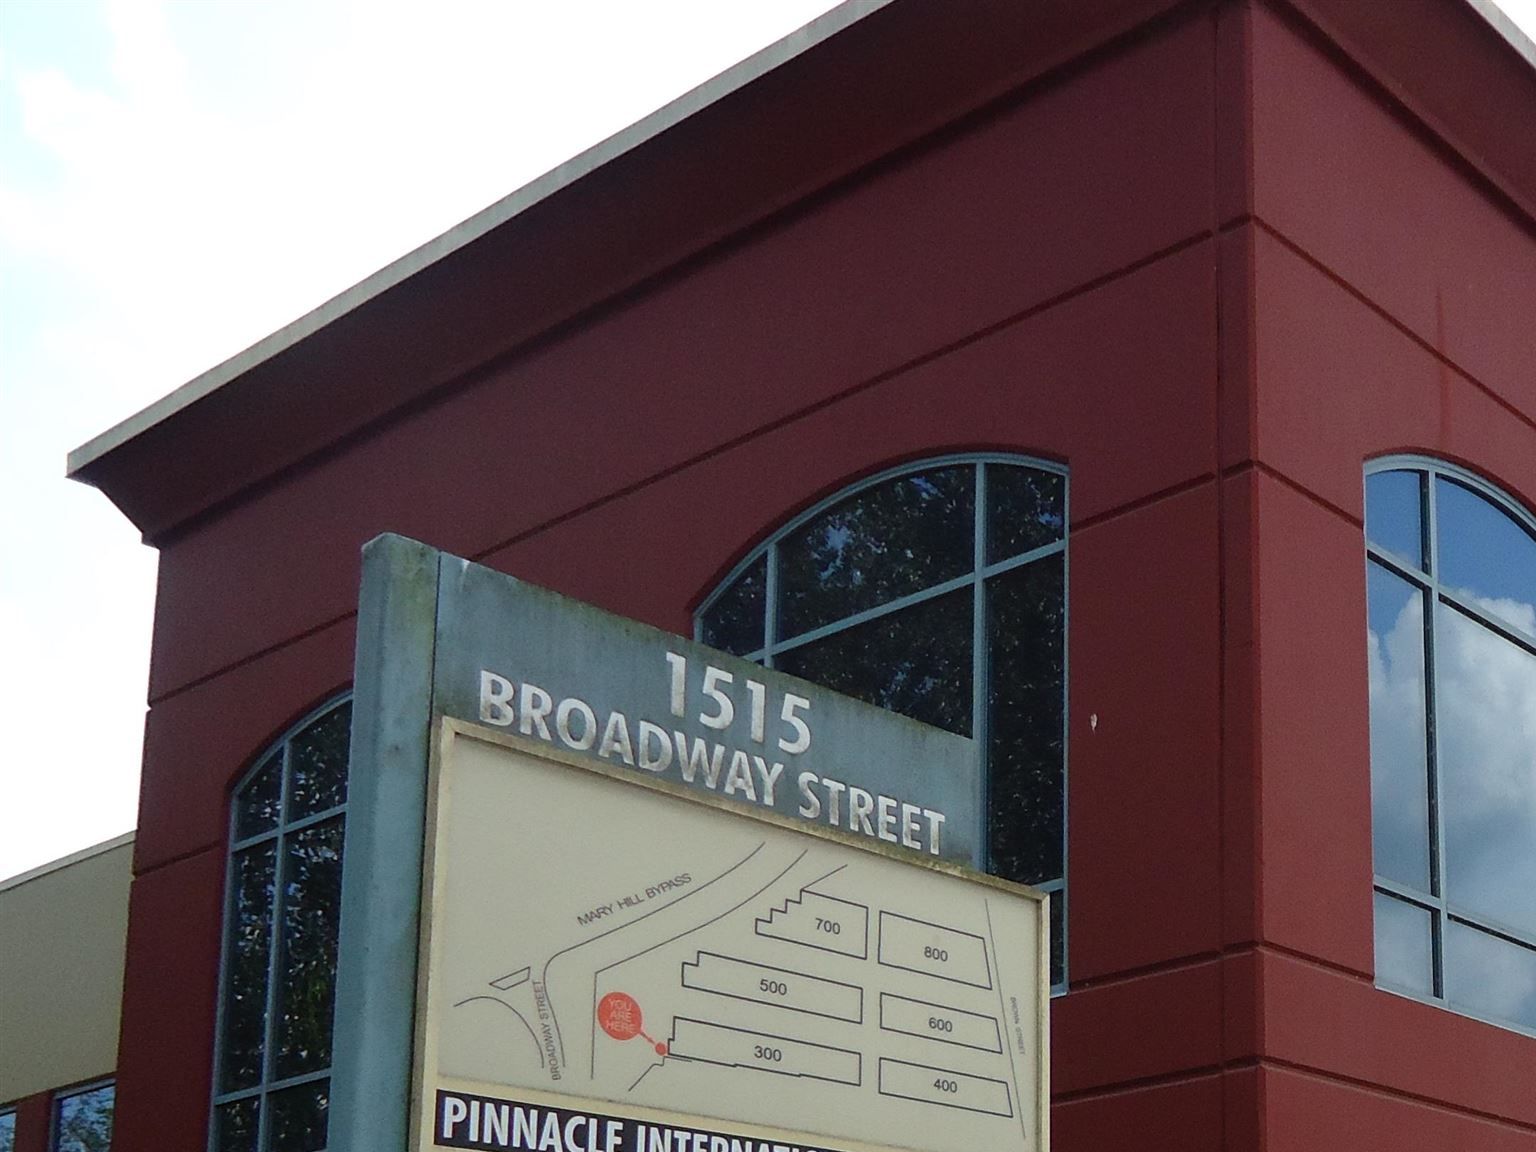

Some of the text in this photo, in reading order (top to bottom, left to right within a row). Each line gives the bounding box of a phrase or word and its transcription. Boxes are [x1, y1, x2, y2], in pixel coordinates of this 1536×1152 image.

[666, 651, 811, 755] 1515
[479, 669, 945, 855] BROADWAY STREET
[577, 873, 692, 926] MARY HILL BYPASS
[815, 917, 841, 935] 700
[924, 946, 948, 962] 800
[759, 978, 787, 996] 500
[608, 998, 632, 1011] YOU
[609, 1009, 632, 1023] ARE
[533, 979, 562, 1081] BROADWAY STREET
[606, 1019, 638, 1033] HERE
[929, 1017, 953, 1033] 600
[754, 1045, 782, 1062] 300
[933, 1078, 958, 1093] 400
